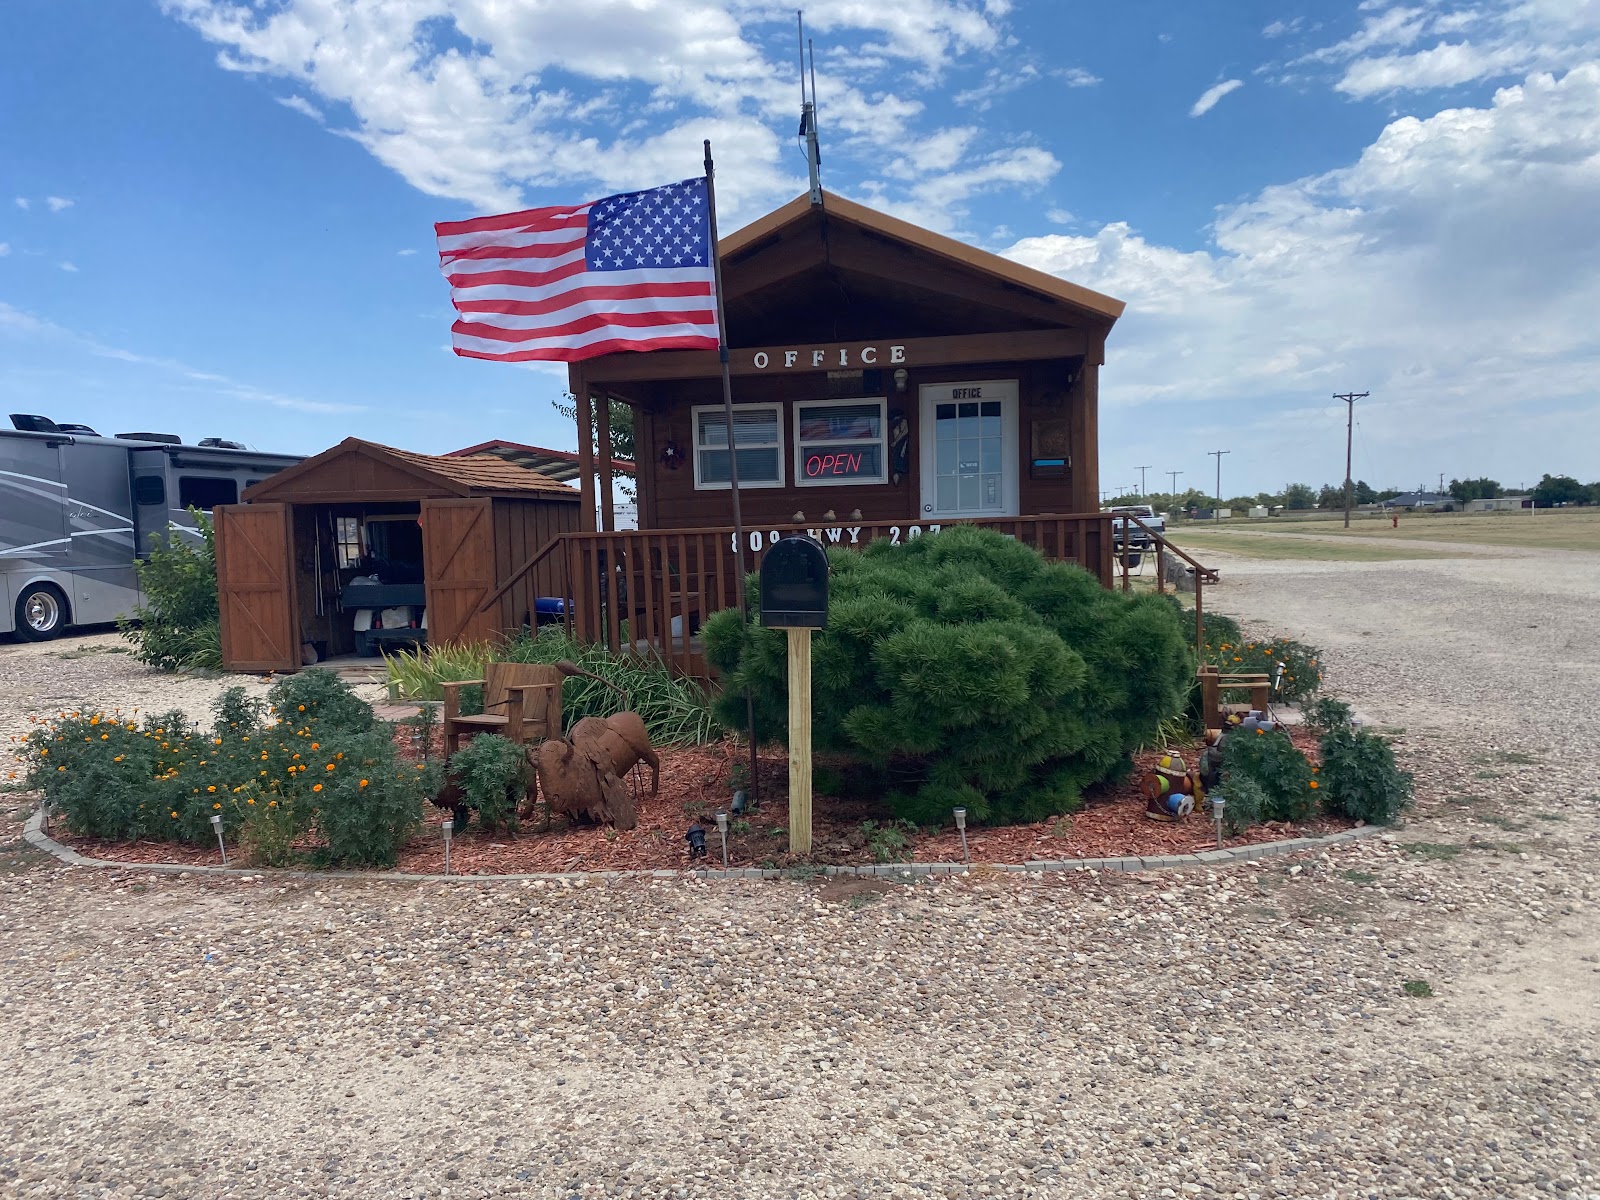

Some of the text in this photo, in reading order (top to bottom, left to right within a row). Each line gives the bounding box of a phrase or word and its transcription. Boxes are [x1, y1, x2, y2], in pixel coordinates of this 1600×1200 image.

[753, 345, 906, 369] OFFICE
[952, 387, 982, 399] OFFICE
[806, 453, 862, 477] OPEN
[806, 526, 862, 545] HWY
